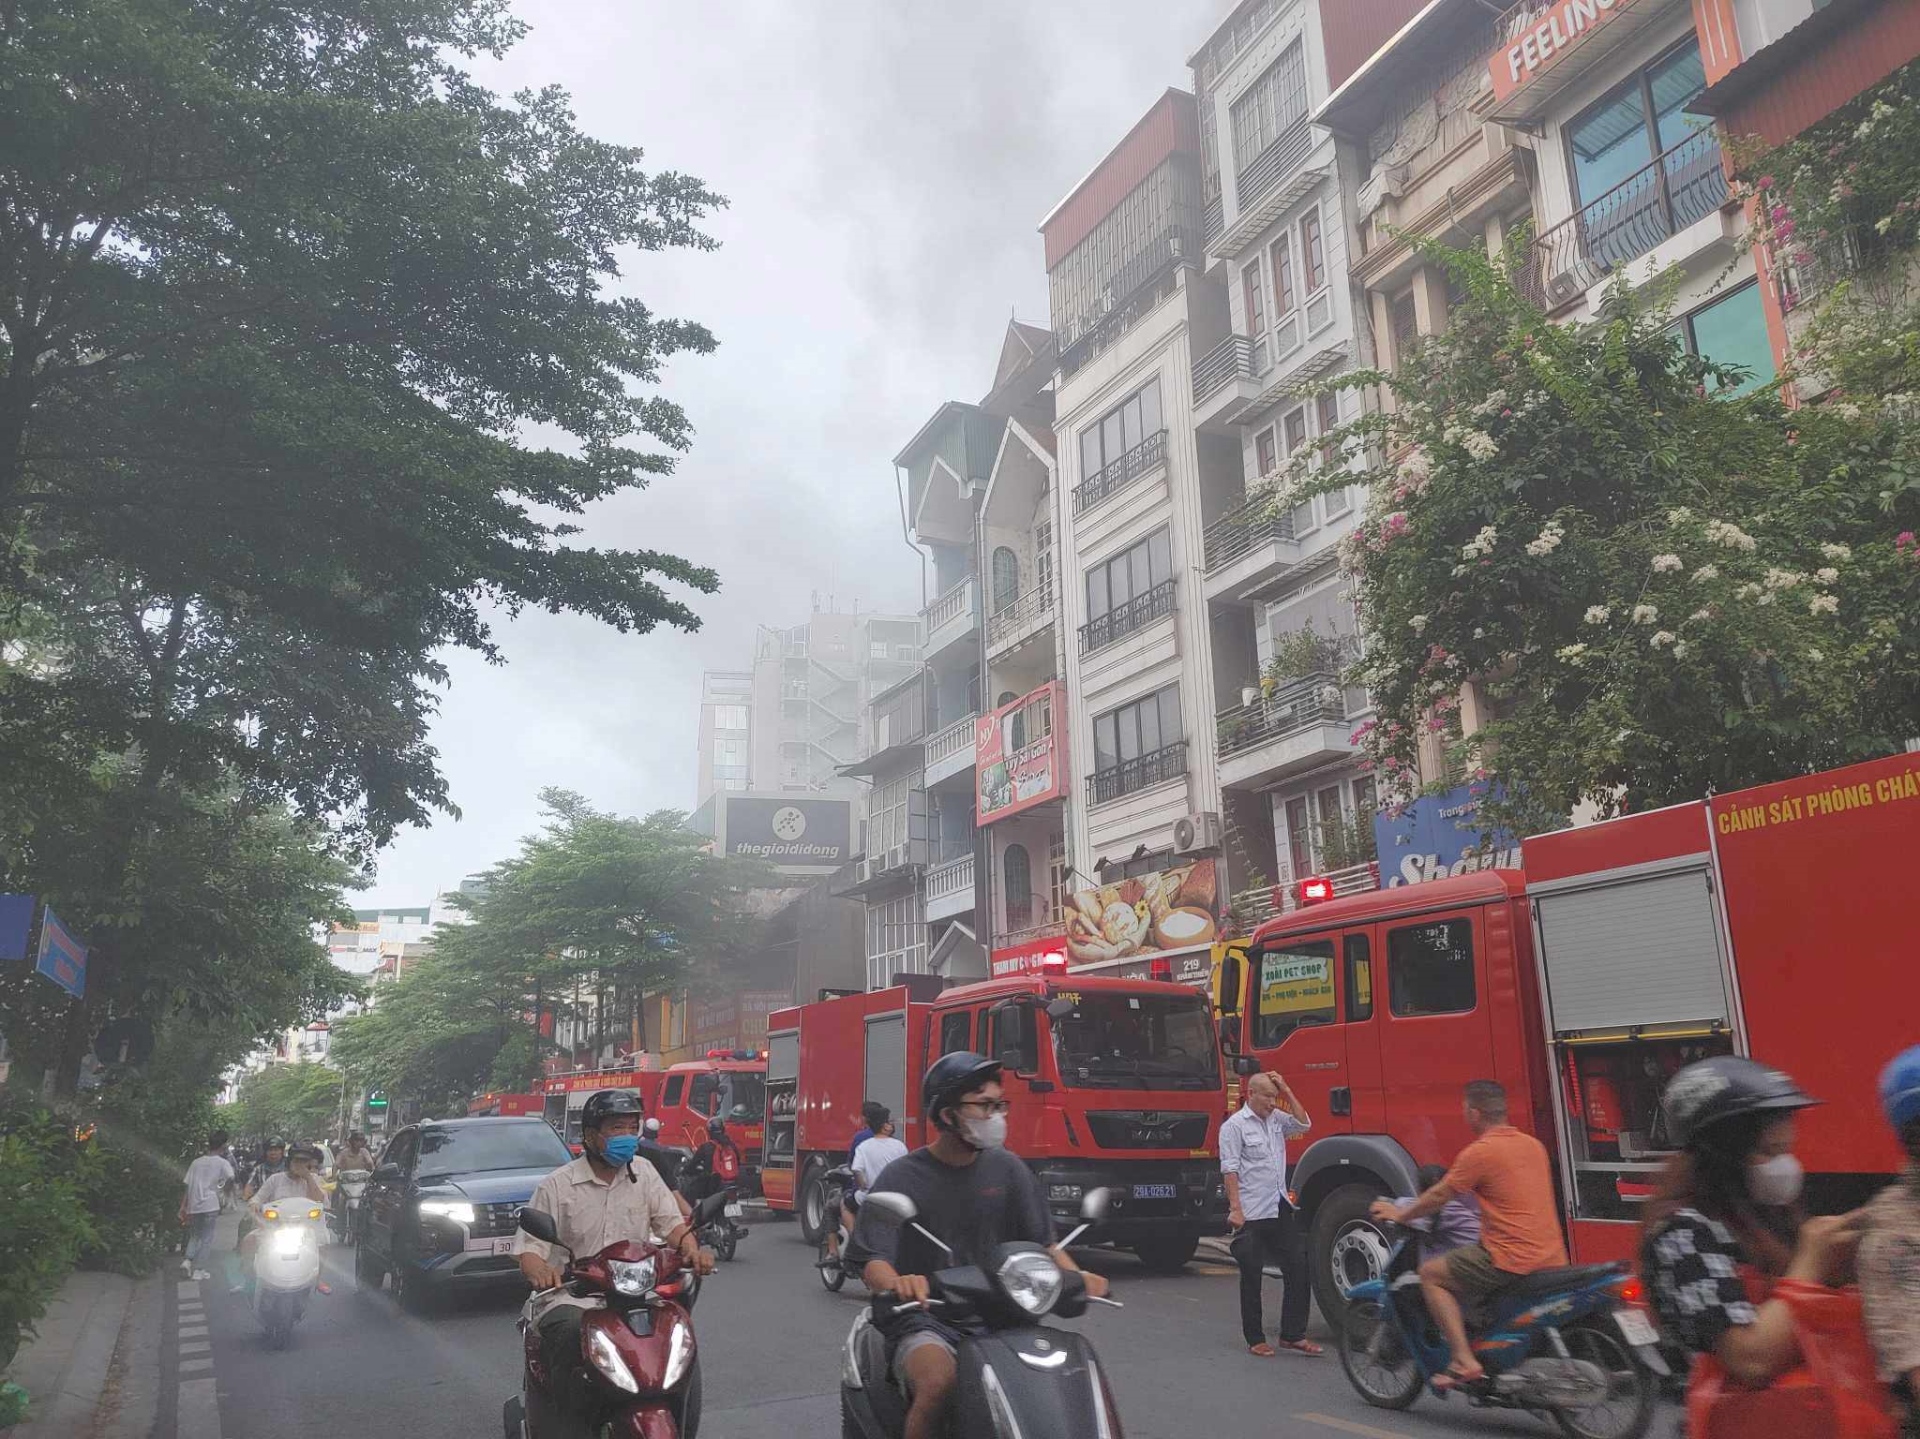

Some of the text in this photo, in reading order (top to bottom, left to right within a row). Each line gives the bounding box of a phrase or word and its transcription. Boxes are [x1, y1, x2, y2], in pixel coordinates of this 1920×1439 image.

[1507, 0, 1616, 82] FEELIN
[1718, 804, 1766, 834] CẢNH
[1769, 795, 1802, 824] SÁT
[1806, 785, 1873, 817] PHÒNG
[736, 843, 840, 858] thegioididong
[1183, 958, 1200, 972] 219
[1284, 967, 1298, 978] PET
[1301, 963, 1322, 976] SHOP
